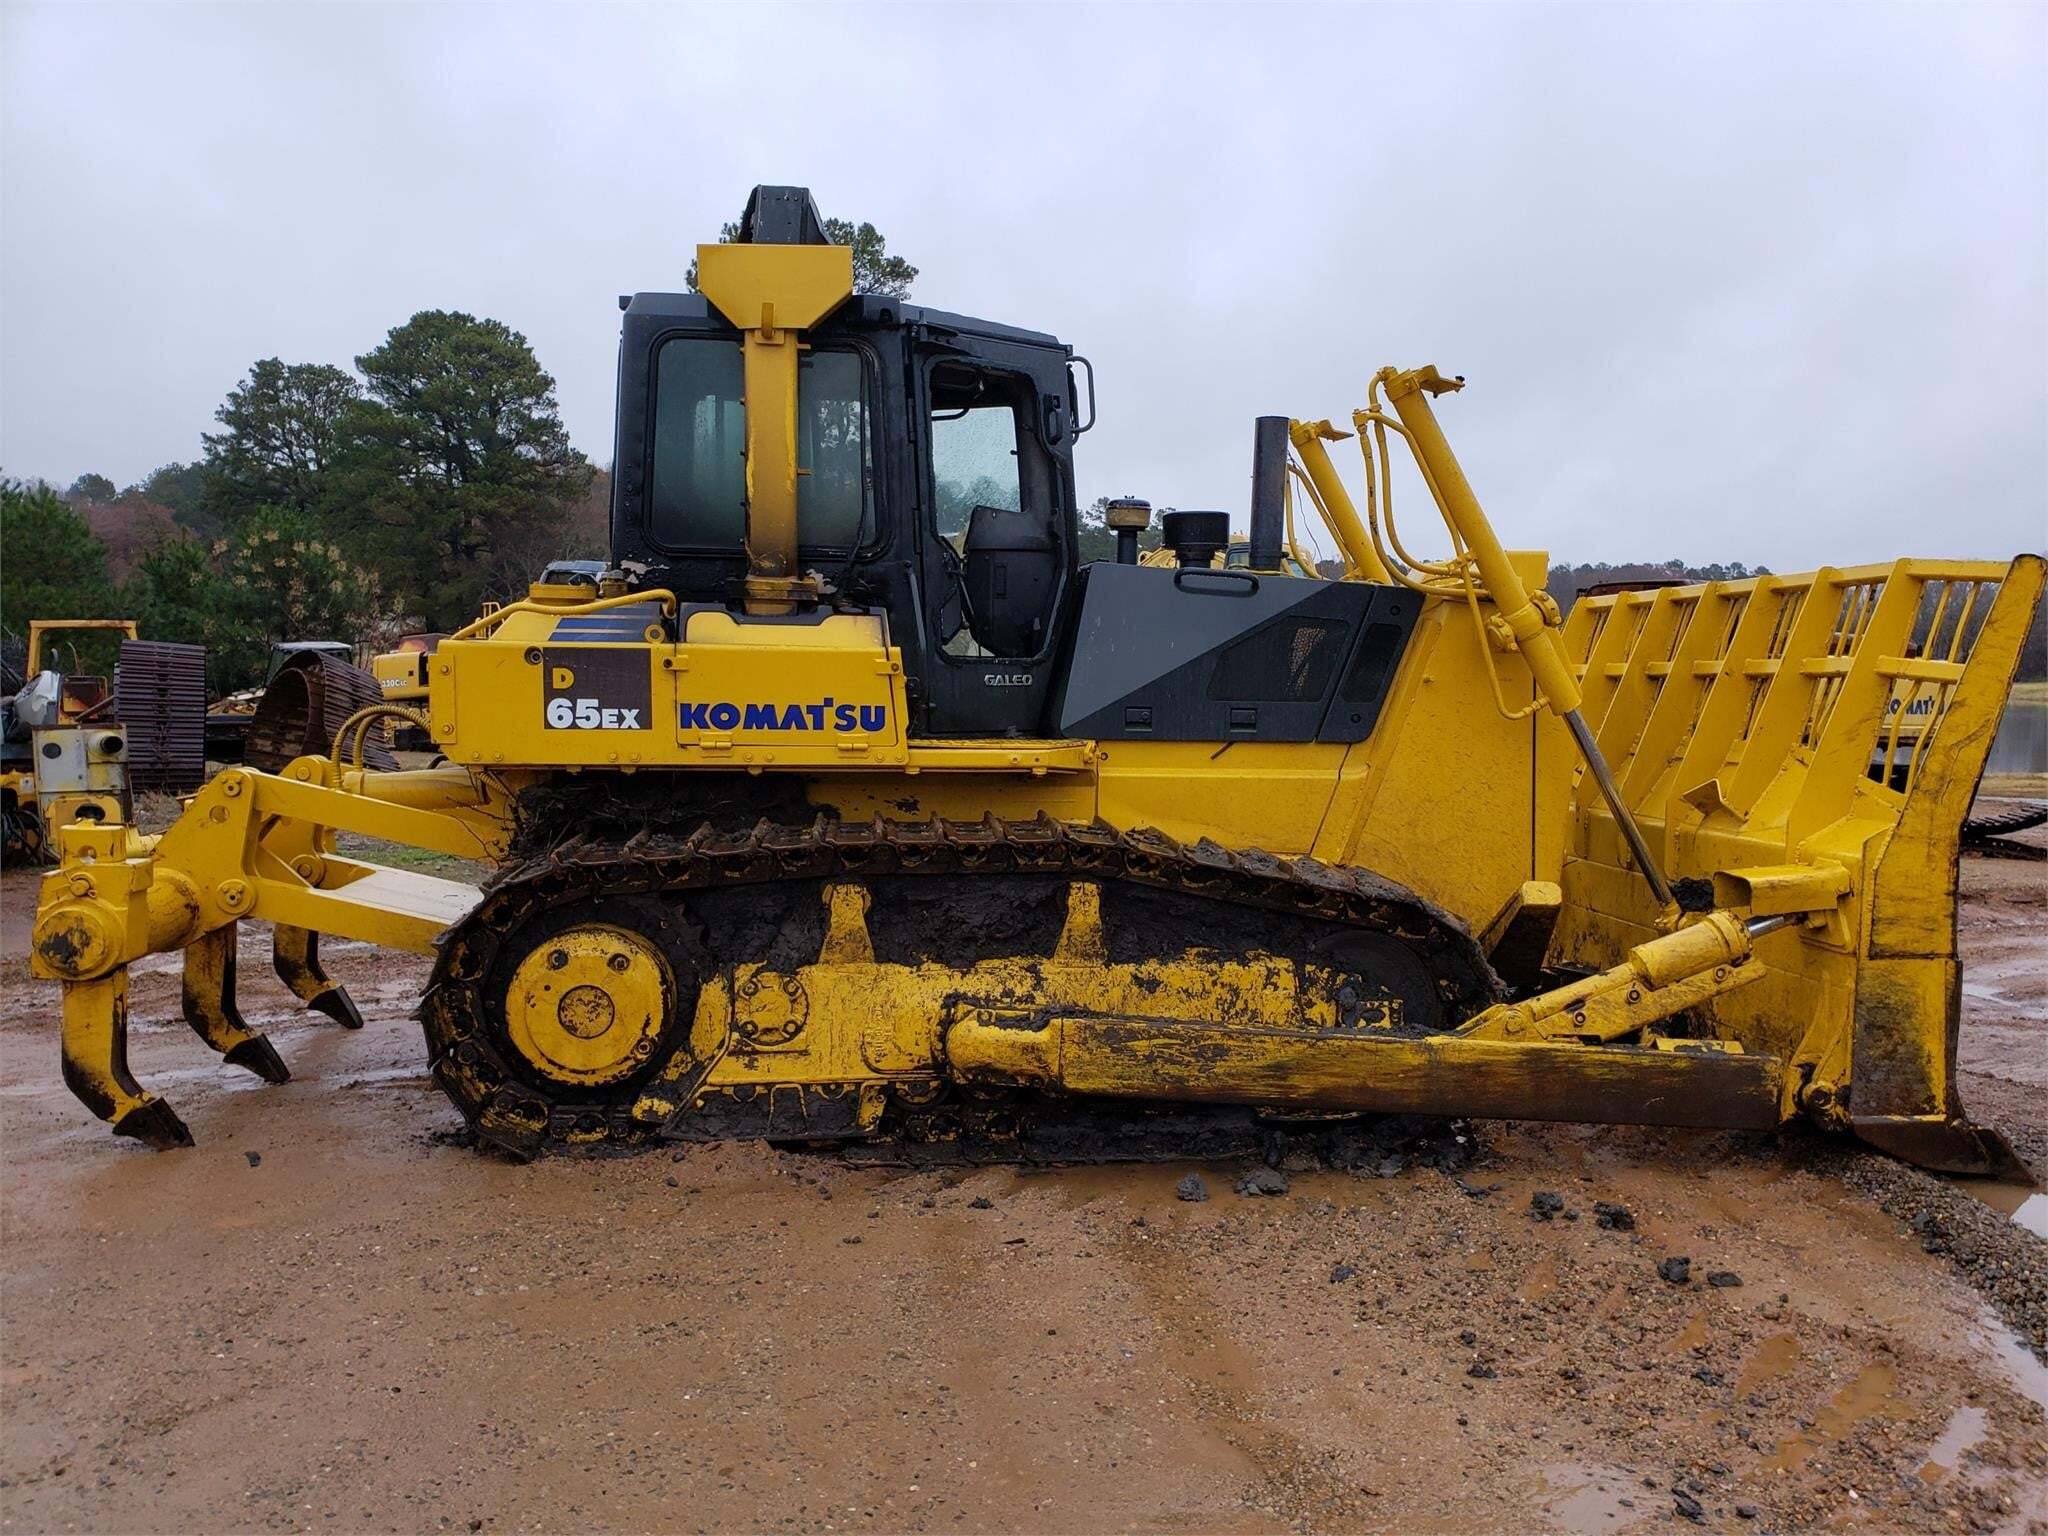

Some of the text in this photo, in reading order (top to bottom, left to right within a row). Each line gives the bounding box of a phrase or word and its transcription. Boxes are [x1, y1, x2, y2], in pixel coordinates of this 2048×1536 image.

[552, 667, 575, 689] D
[984, 674, 1033, 686] GALEO
[546, 697, 641, 729] 65EX
[679, 697, 886, 732] KOMATSU
